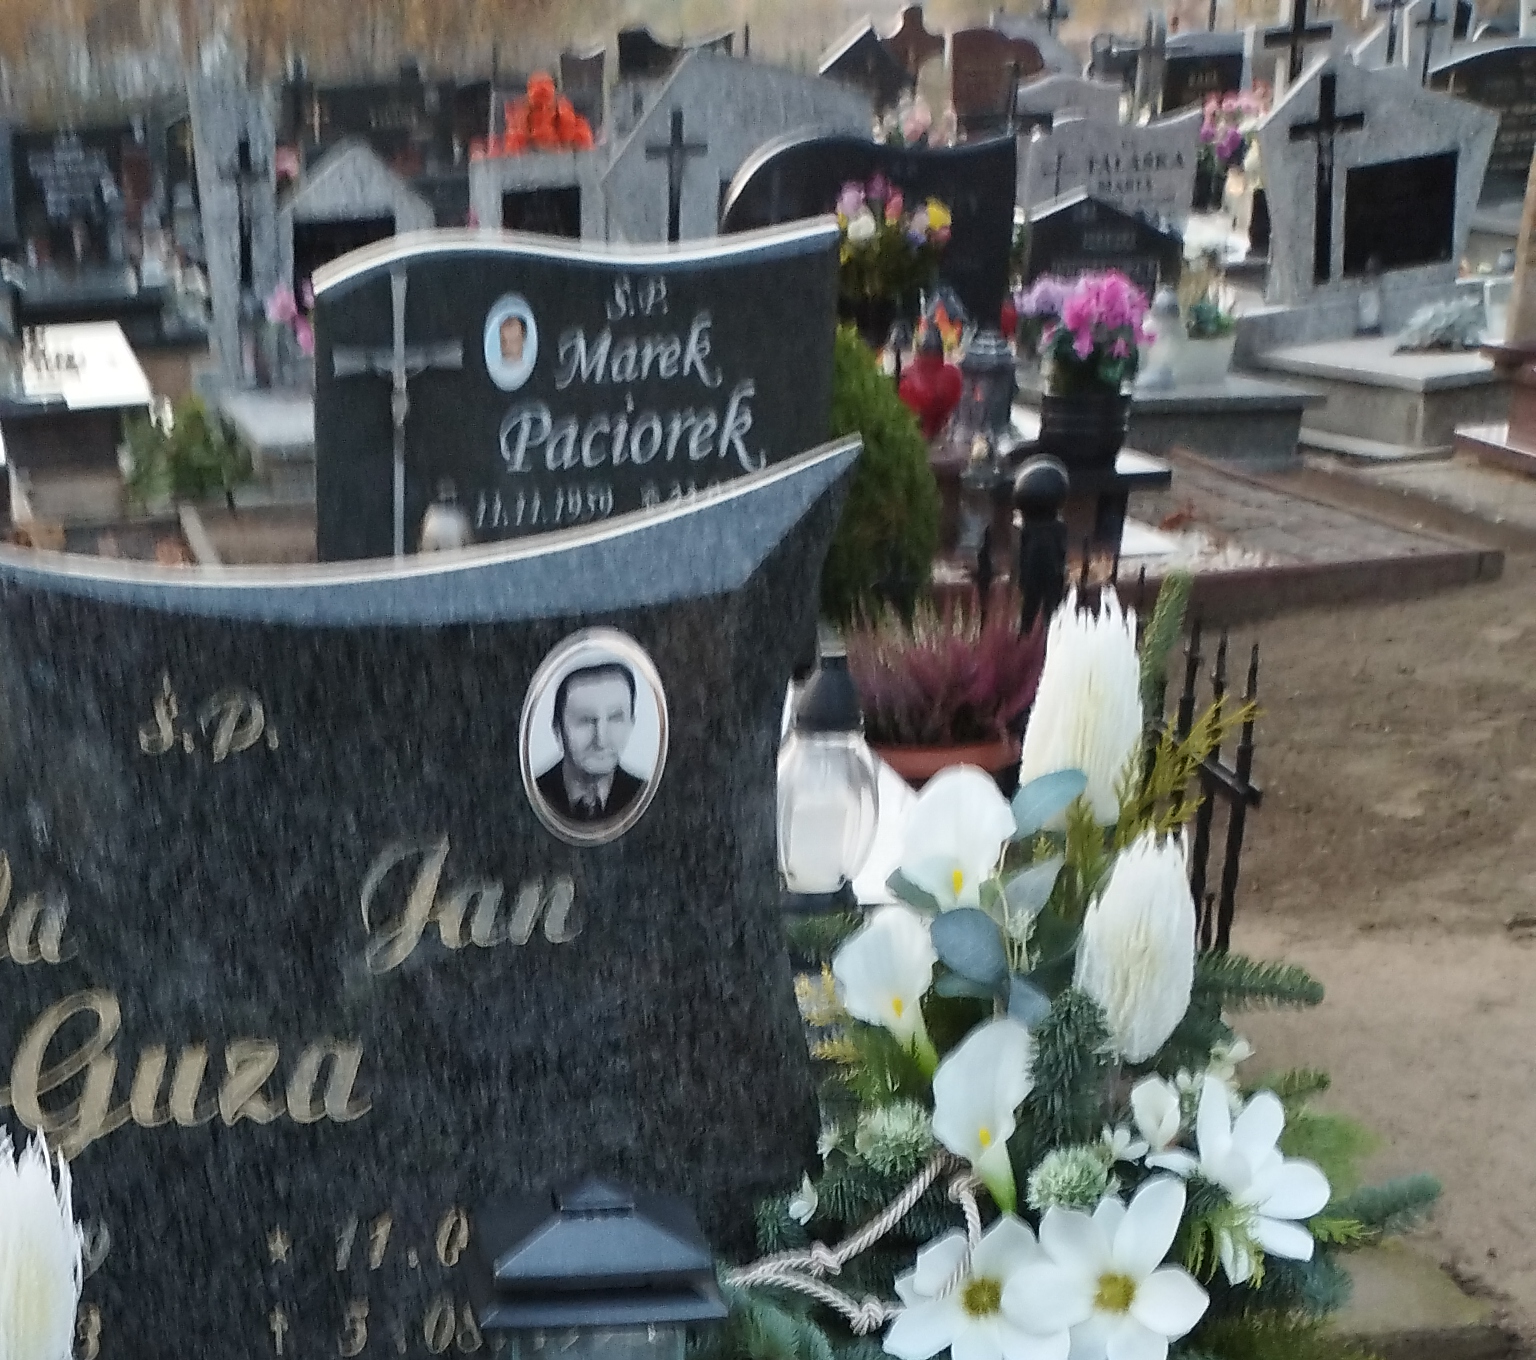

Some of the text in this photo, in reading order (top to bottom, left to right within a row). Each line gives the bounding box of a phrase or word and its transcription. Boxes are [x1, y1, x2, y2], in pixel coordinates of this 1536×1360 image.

[555, 312, 723, 391] Marek
[498, 378, 767, 474] Paciorek
[360, 832, 586, 974] Jan
